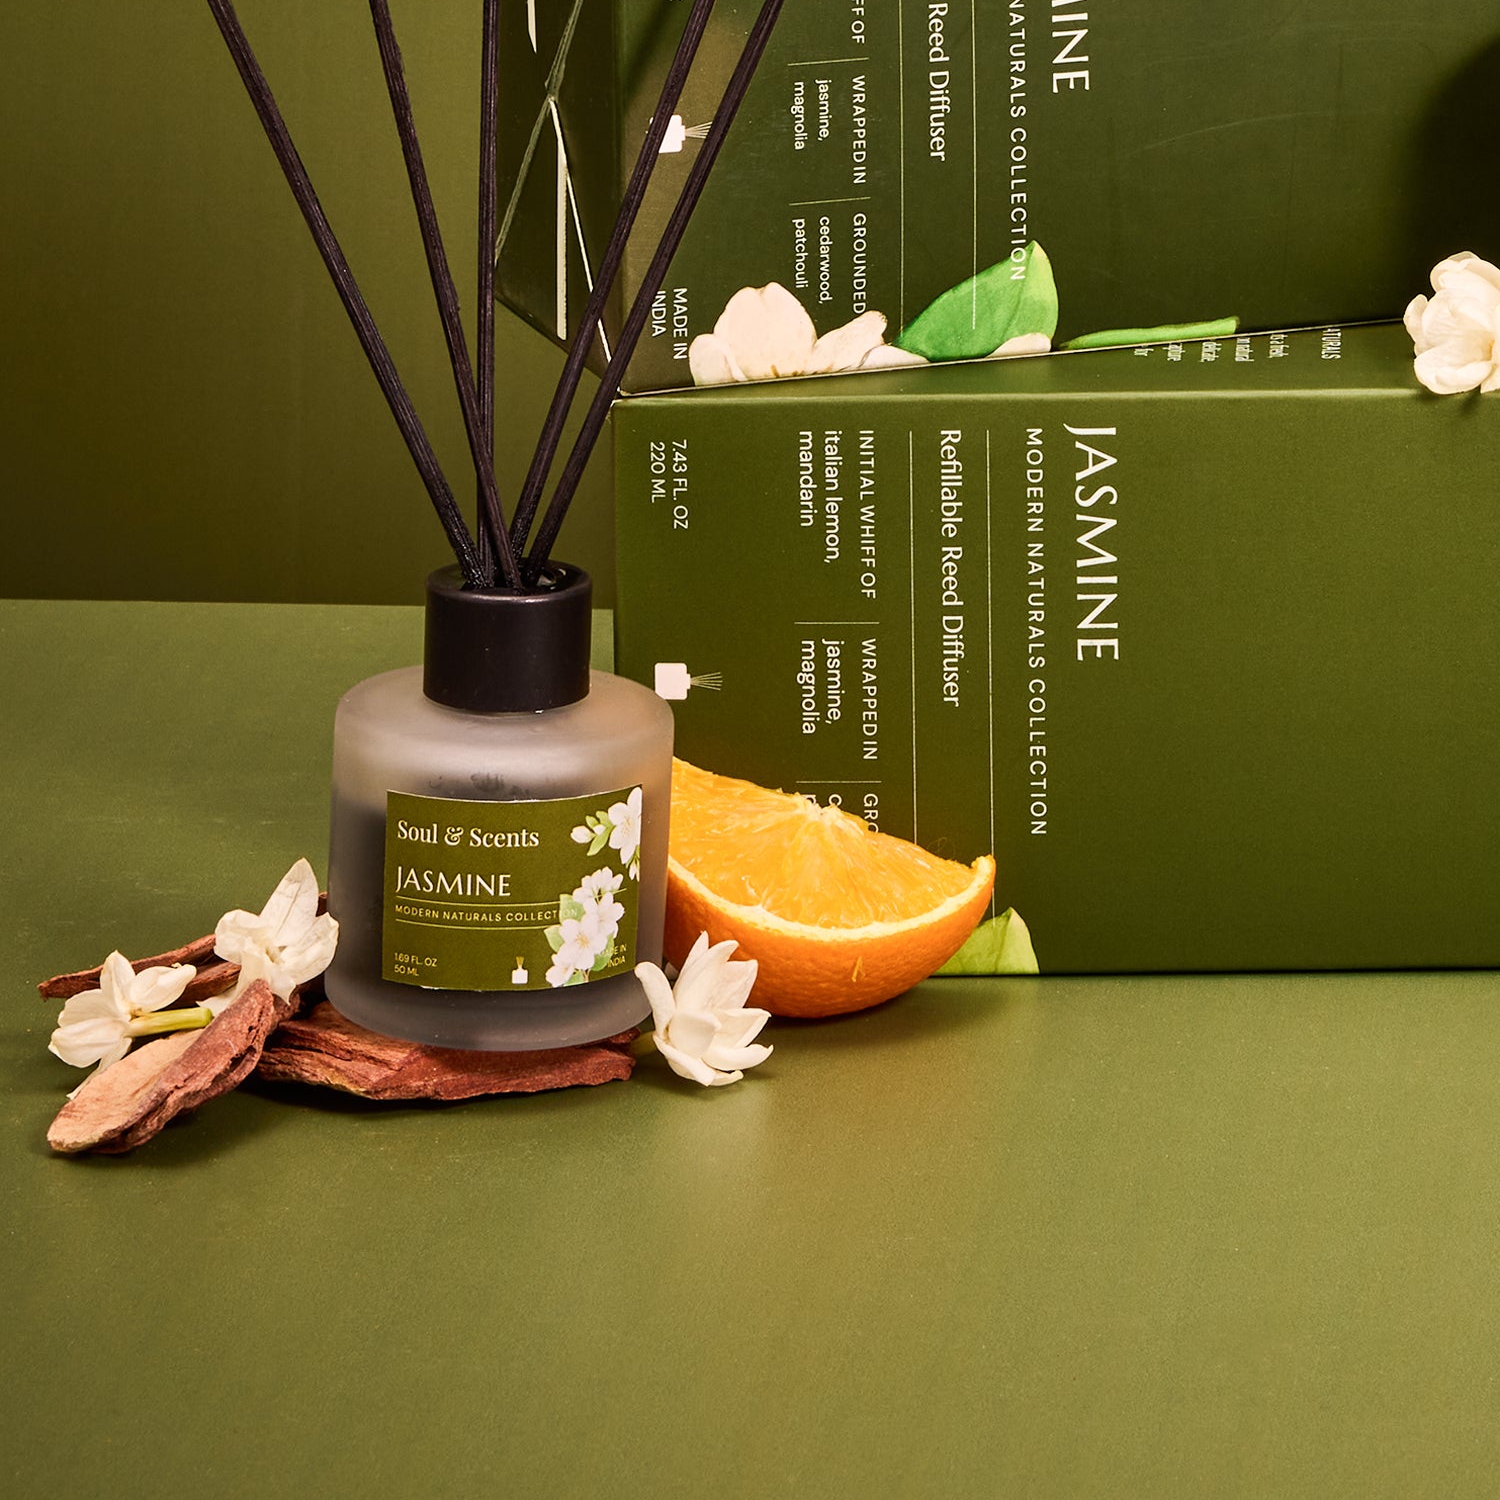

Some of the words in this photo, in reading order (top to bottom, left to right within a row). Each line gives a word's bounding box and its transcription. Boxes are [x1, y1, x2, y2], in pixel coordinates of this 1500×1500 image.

[851, 20, 865, 44] OF
[928, 3, 950, 63] Reed
[790, 81, 808, 150] magnolia
[815, 79, 832, 141] jasmine,
[852, 75, 866, 163] WRAPPED
[929, 70, 950, 162] Diffuser
[853, 166, 866, 184] IN
[1010, 127, 1027, 280] COLLECTION
[792, 218, 808, 289] patchouli
[819, 216, 833, 304] cedarwood,
[853, 213, 867, 314] GROUNDED
[651, 291, 667, 337] INDIA
[673, 288, 688, 338] MADE
[673, 343, 688, 359] IN
[650, 441, 666, 474] 220
[672, 439, 688, 473] 7.43
[799, 431, 818, 527] mandarin
[824, 430, 843, 491] italian
[859, 430, 875, 500] INITIAL
[940, 429, 963, 538] Refillable
[1026, 428, 1044, 532] MODERN
[651, 479, 666, 503] ML
[673, 478, 688, 501] FL.
[673, 505, 689, 529] OZ
[824, 497, 843, 564] lemon,
[860, 505, 876, 568] WHIFF
[1063, 423, 1120, 661] JASMINE
[860, 572, 876, 599] OF
[941, 546, 964, 606] Reed
[1027, 543, 1046, 668] NATURALS
[796, 640, 820, 735] magnolia
[821, 638, 845, 724] jasmine,
[861, 638, 878, 737] WRAPPED
[942, 615, 964, 708] Diffuser
[863, 741, 878, 760] IN
[1028, 678, 1048, 835] COLLECTION
[397, 819, 438, 844] Soul
[444, 827, 464, 846] &
[470, 828, 539, 847] Scents
[395, 866, 511, 896] JASMINE
[395, 905, 439, 918] MODERN
[443, 911, 502, 922] NATURALS
[394, 964, 406, 974] 50
[407, 967, 419, 976] ML
[424, 957, 438, 967] OZ
